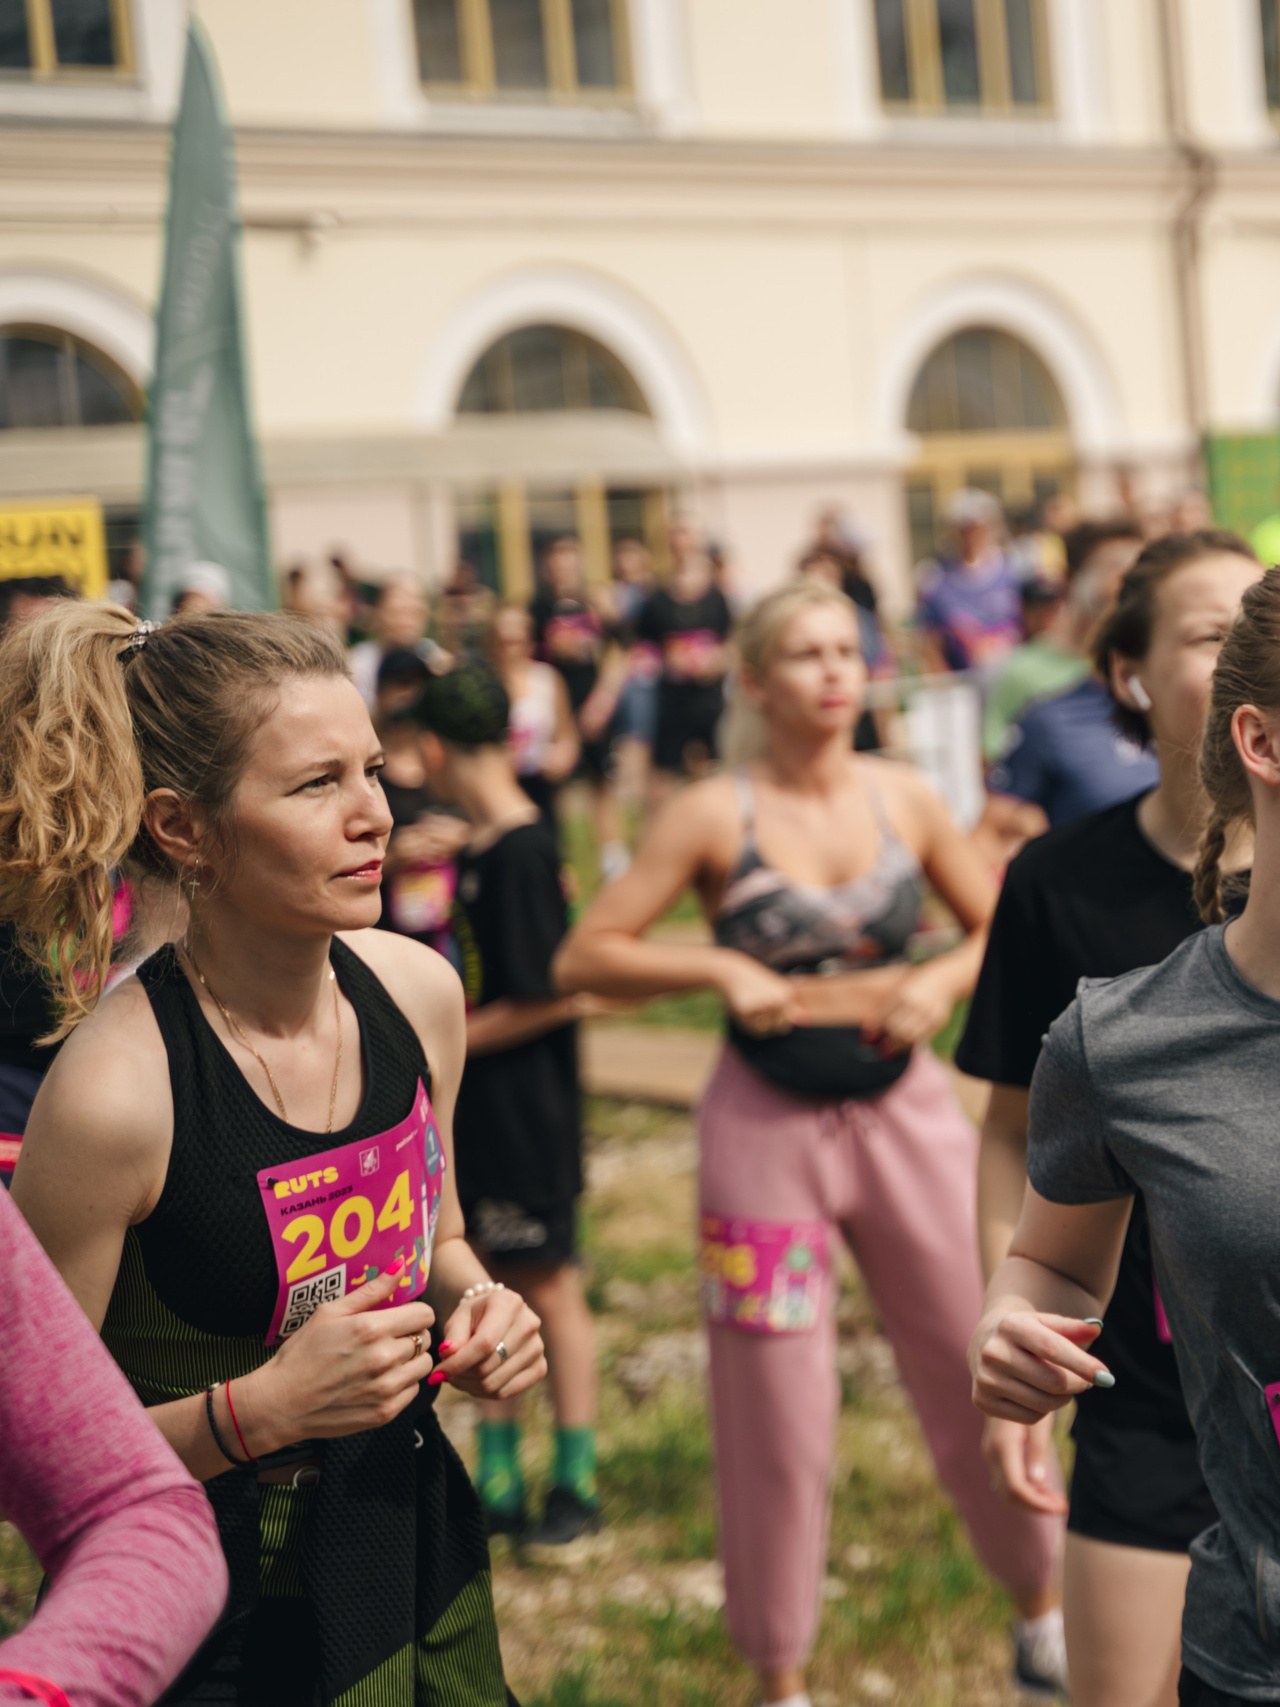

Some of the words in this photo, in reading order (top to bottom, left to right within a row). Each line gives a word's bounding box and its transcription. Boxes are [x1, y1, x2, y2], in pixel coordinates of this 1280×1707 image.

[274, 1166, 339, 1199] RUTS
[281, 1196, 328, 1216] КАЗАНЬ
[329, 1185, 354, 1201] 2023
[281, 1168, 415, 1284] 204
